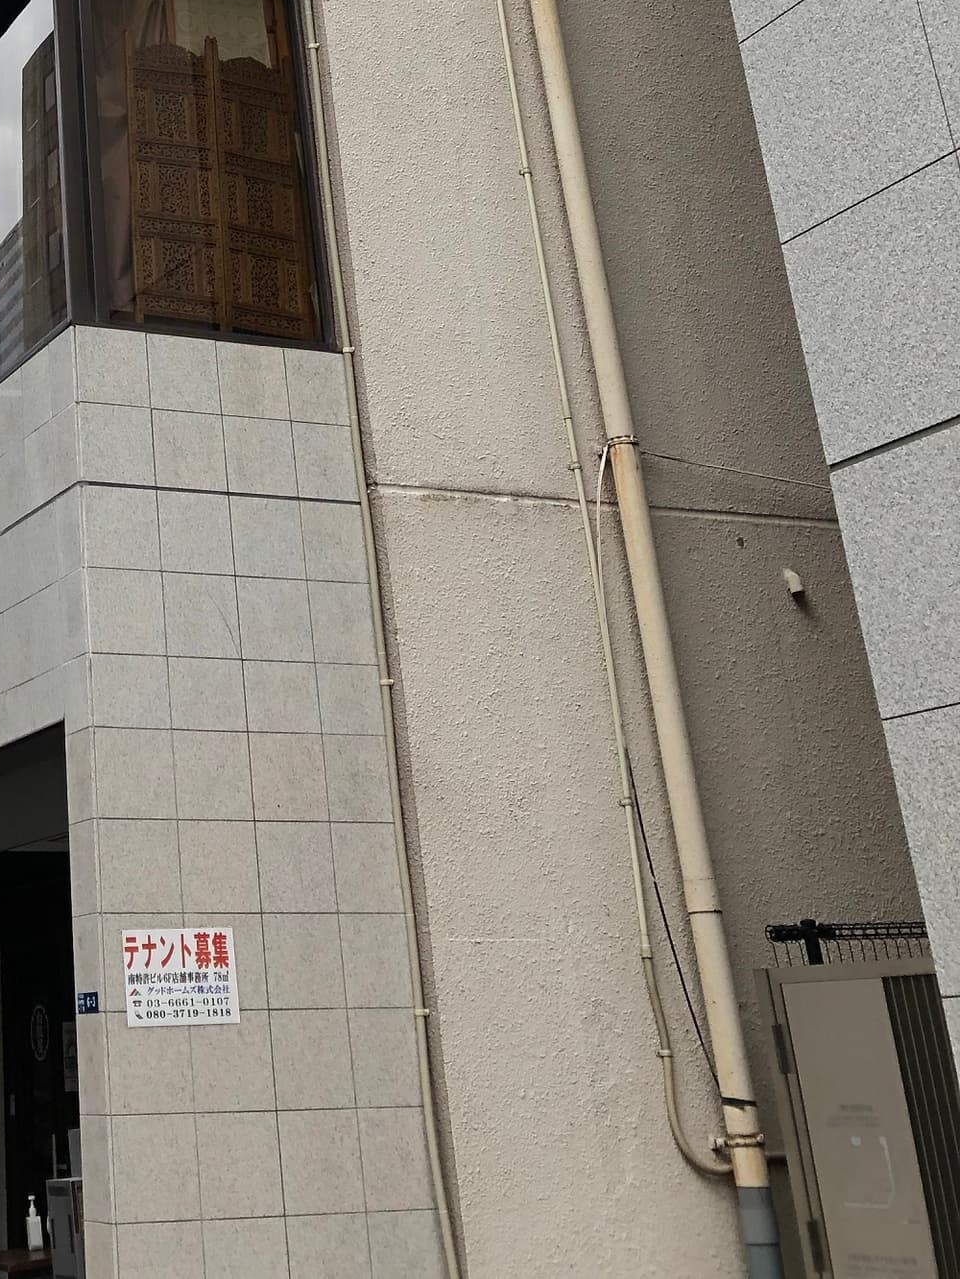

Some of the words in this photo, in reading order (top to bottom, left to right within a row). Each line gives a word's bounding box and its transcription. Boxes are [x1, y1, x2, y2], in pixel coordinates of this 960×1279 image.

[124, 932, 230, 970] テナント募集
[146, 997, 230, 1008] 03-6661-0107
[146, 1008, 232, 1019] 080-3719-1818
